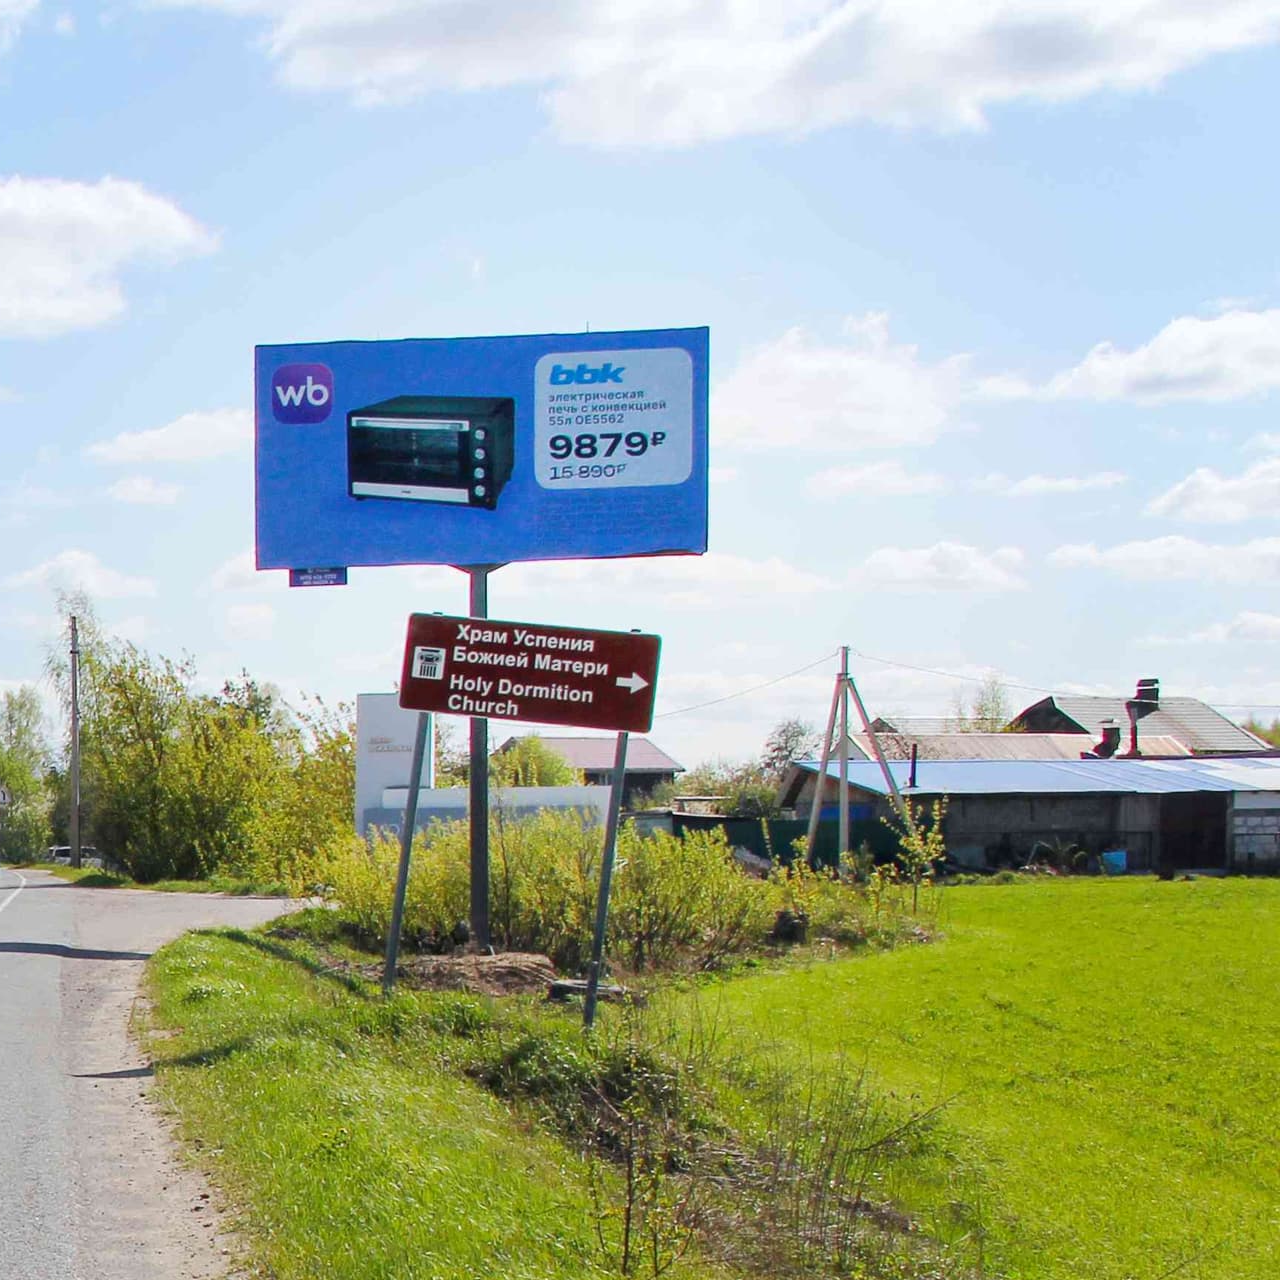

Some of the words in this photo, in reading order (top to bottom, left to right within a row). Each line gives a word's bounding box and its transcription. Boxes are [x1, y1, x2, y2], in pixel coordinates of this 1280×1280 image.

[549, 363, 625, 385] bbk
[275, 376, 329, 407] wb
[549, 390, 644, 402] электрическая
[548, 404, 578, 414] печь
[581, 405, 588, 413] с
[591, 400, 666, 412] конвекцией
[549, 416, 572, 426] 55л
[456, 624, 508, 644] Храм
[513, 629, 595, 652] Успения
[453, 646, 528, 668] Божией
[534, 653, 608, 677] Матери
[449, 674, 493, 696] Holy
[498, 679, 594, 703] Dormition
[448, 694, 519, 716] Church
